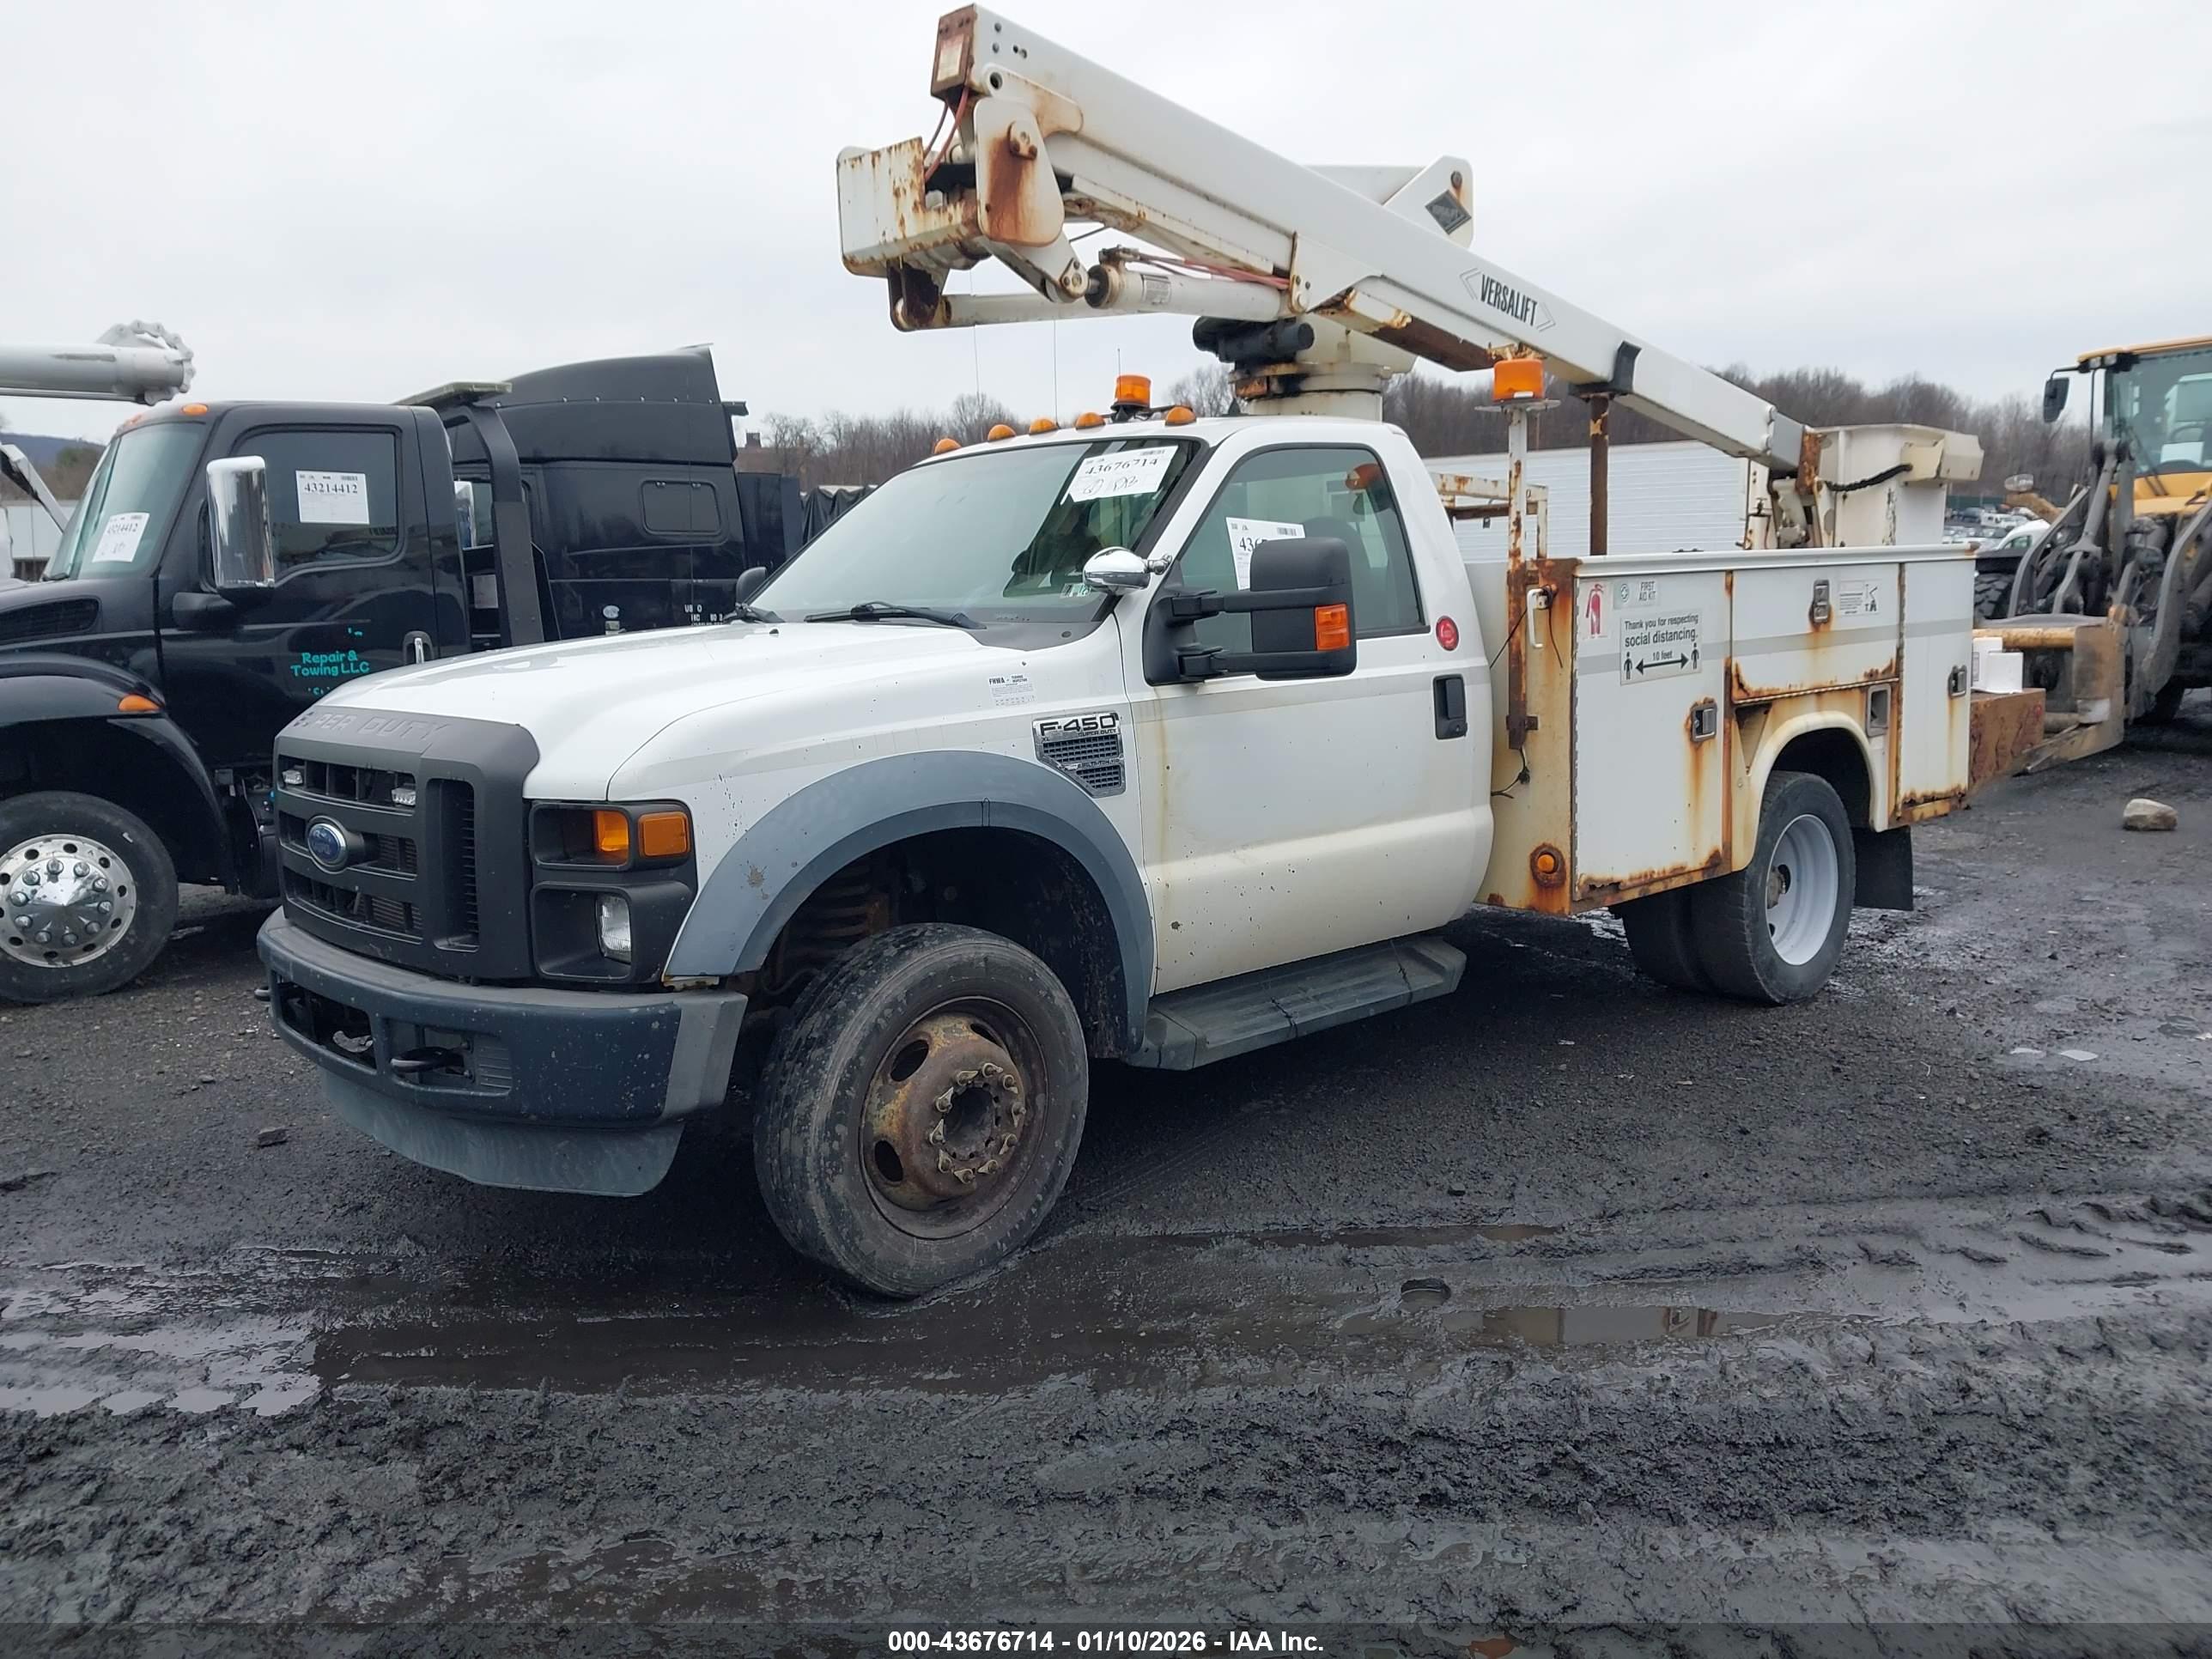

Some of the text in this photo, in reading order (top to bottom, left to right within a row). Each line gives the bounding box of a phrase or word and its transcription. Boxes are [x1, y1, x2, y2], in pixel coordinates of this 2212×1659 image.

[1480, 273, 1538, 327] VERSALIFT
[1085, 458, 1158, 476] 43676714
[304, 483, 358, 494] 43214412
[1641, 580, 1655, 591] FIRST
[1648, 591, 1656, 600] KIT
[1625, 614, 1698, 631] Thank you for respecting
[1625, 632, 1650, 647] social
[1652, 628, 1698, 642] distancing.
[301, 650, 358, 666] Repair &
[1653, 650, 1673, 661] 10 feet
[290, 661, 370, 677] Towing LLC
[356, 715, 451, 741] DUTY
[1040, 714, 1116, 737] F-450
